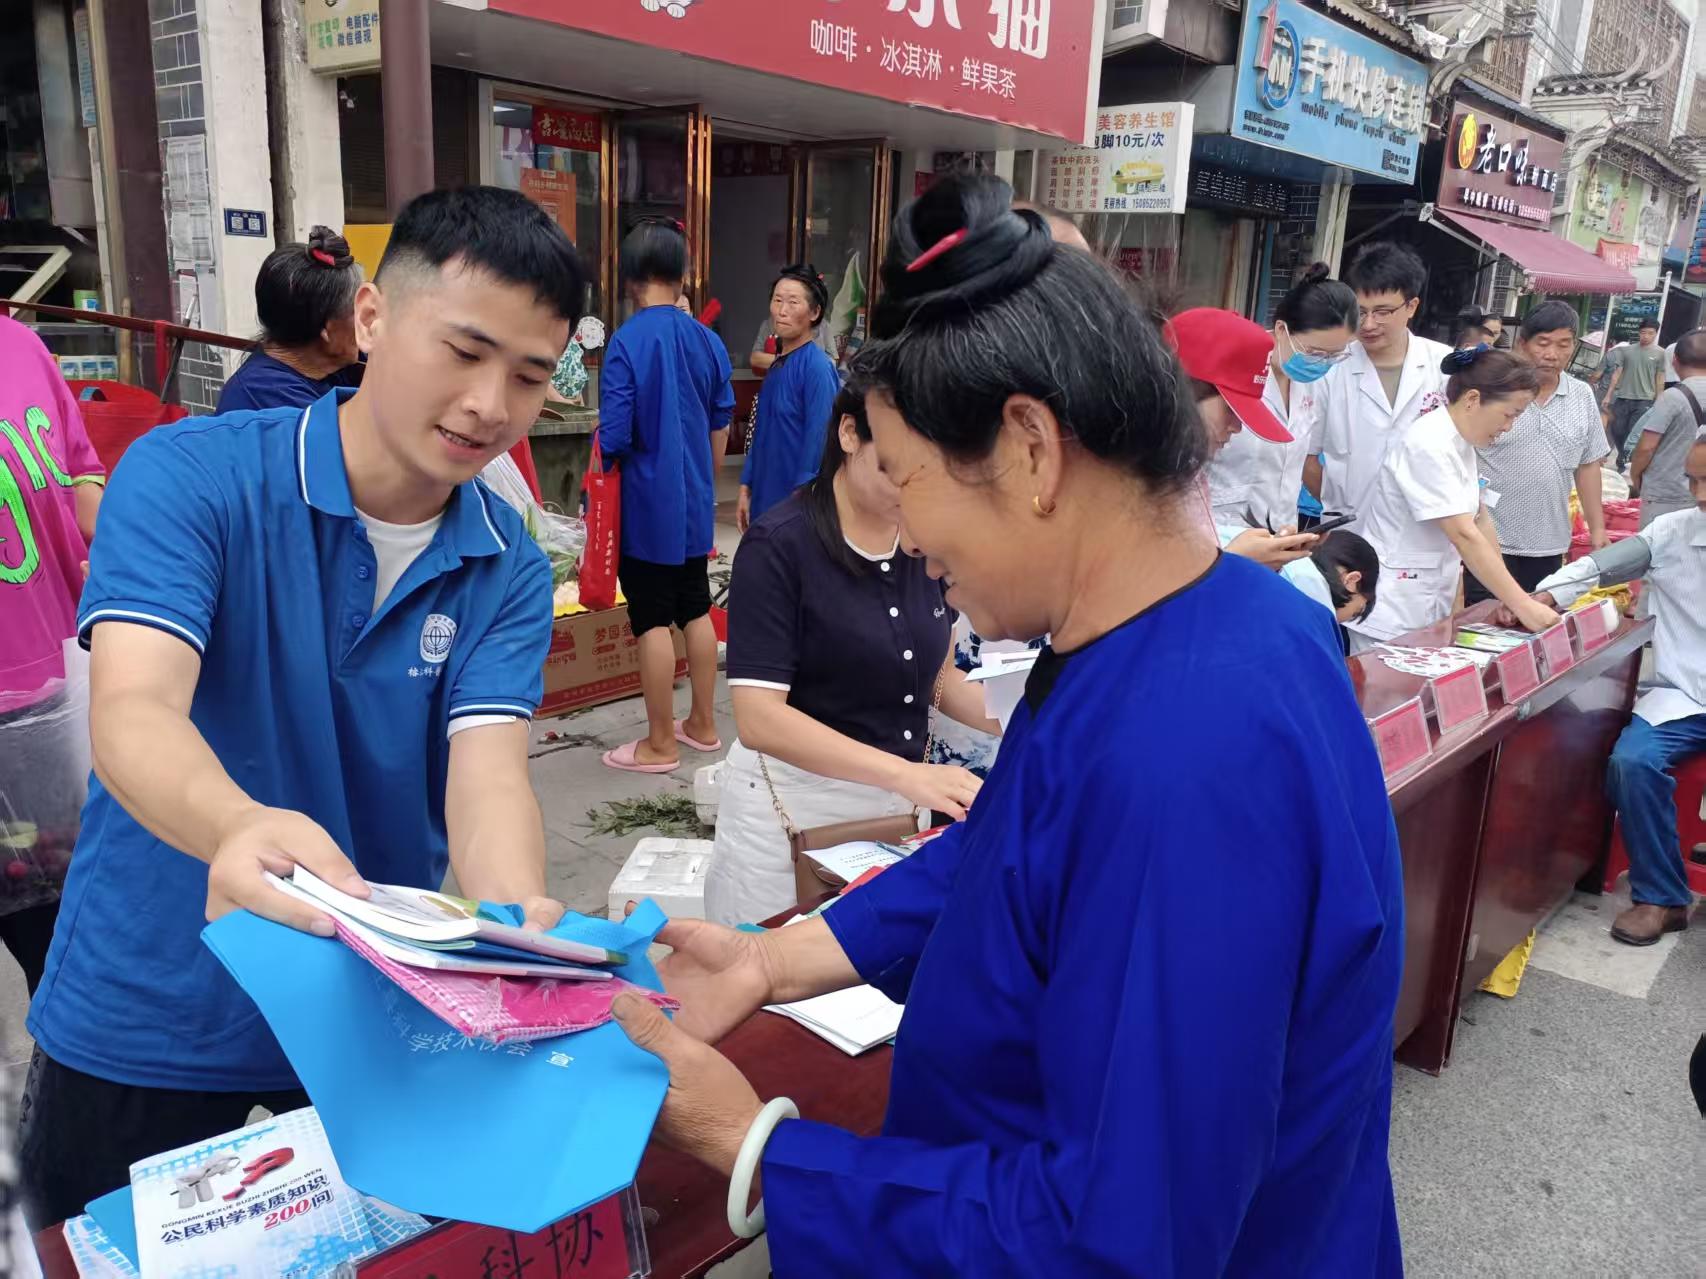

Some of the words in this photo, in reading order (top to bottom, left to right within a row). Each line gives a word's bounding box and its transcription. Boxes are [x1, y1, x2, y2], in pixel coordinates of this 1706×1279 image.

[1301, 102, 1329, 120] mobile
[161, 1174, 331, 1244] 公民科学素质知识
[264, 1190, 335, 1230] 200问
